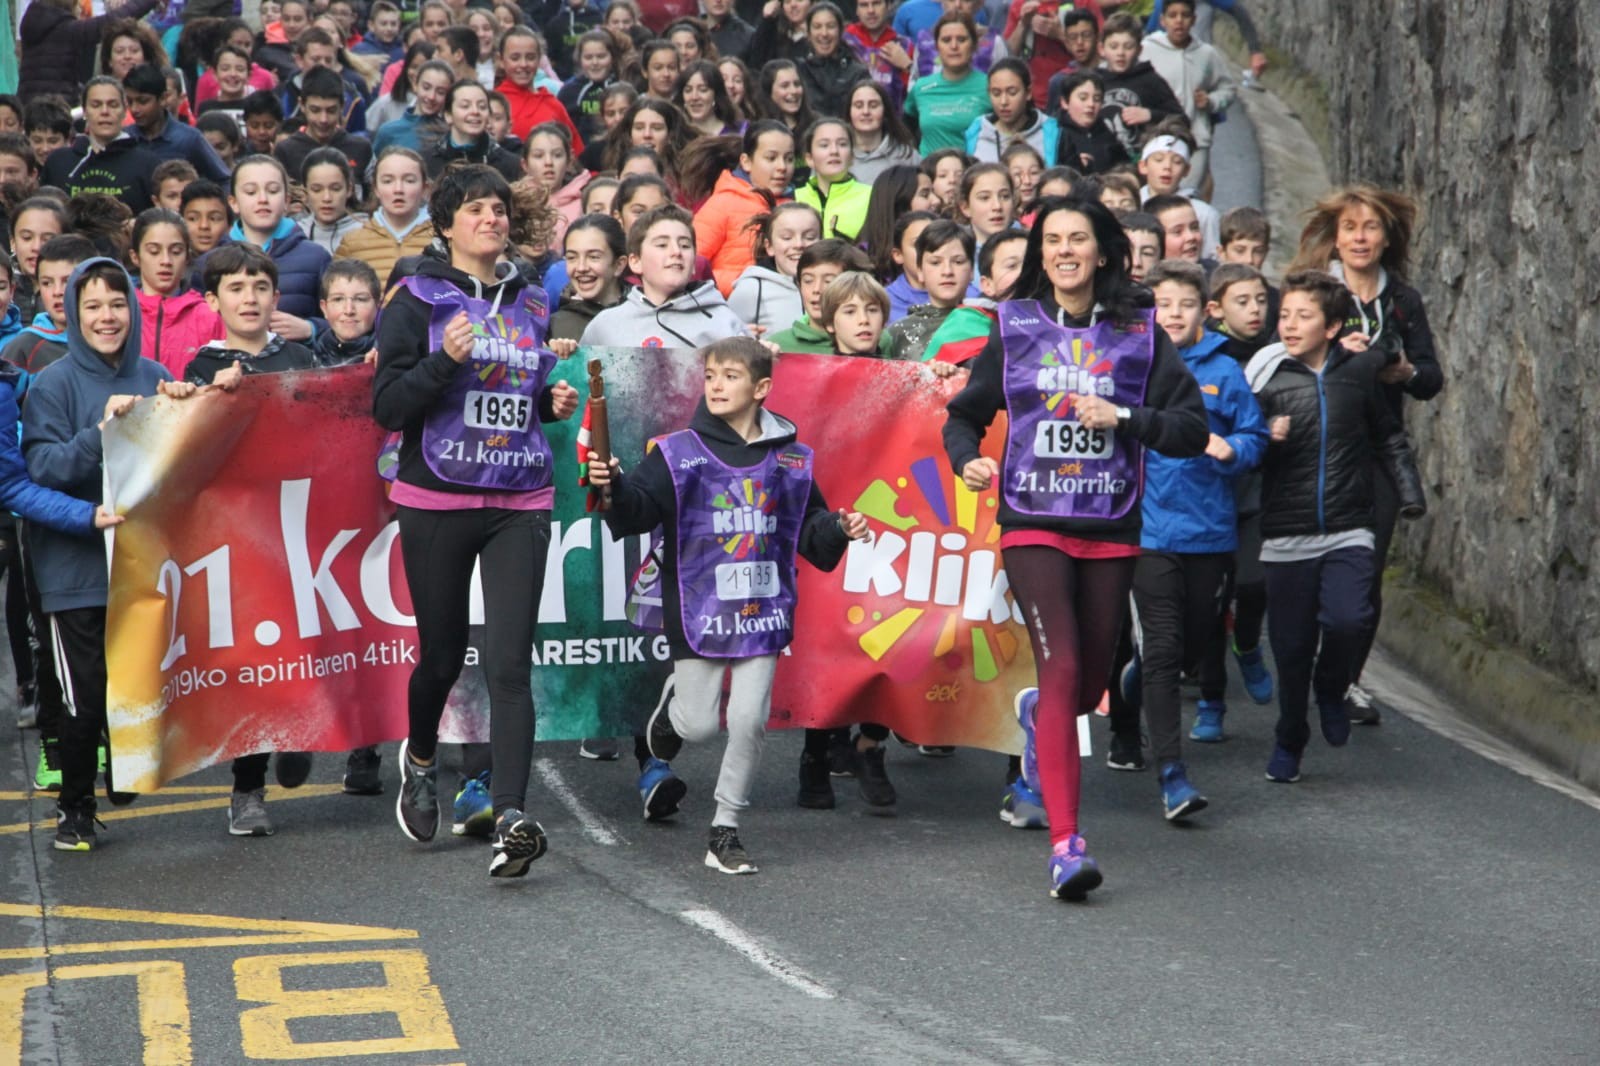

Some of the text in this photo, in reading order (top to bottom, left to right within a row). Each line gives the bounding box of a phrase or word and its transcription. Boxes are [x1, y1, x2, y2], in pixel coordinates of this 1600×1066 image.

[474, 395, 528, 429] 1935
[1044, 424, 1107, 454] 1935
[438, 439, 545, 468] 21. korrika
[1015, 469, 1127, 495] 21. korrika
[1057, 460, 1084, 476] aek
[726, 565, 771, 590] 1935
[700, 608, 790, 636] 21. korrik
[238, 652, 356, 688] apirilaren
[363, 640, 416, 667] 4tik
